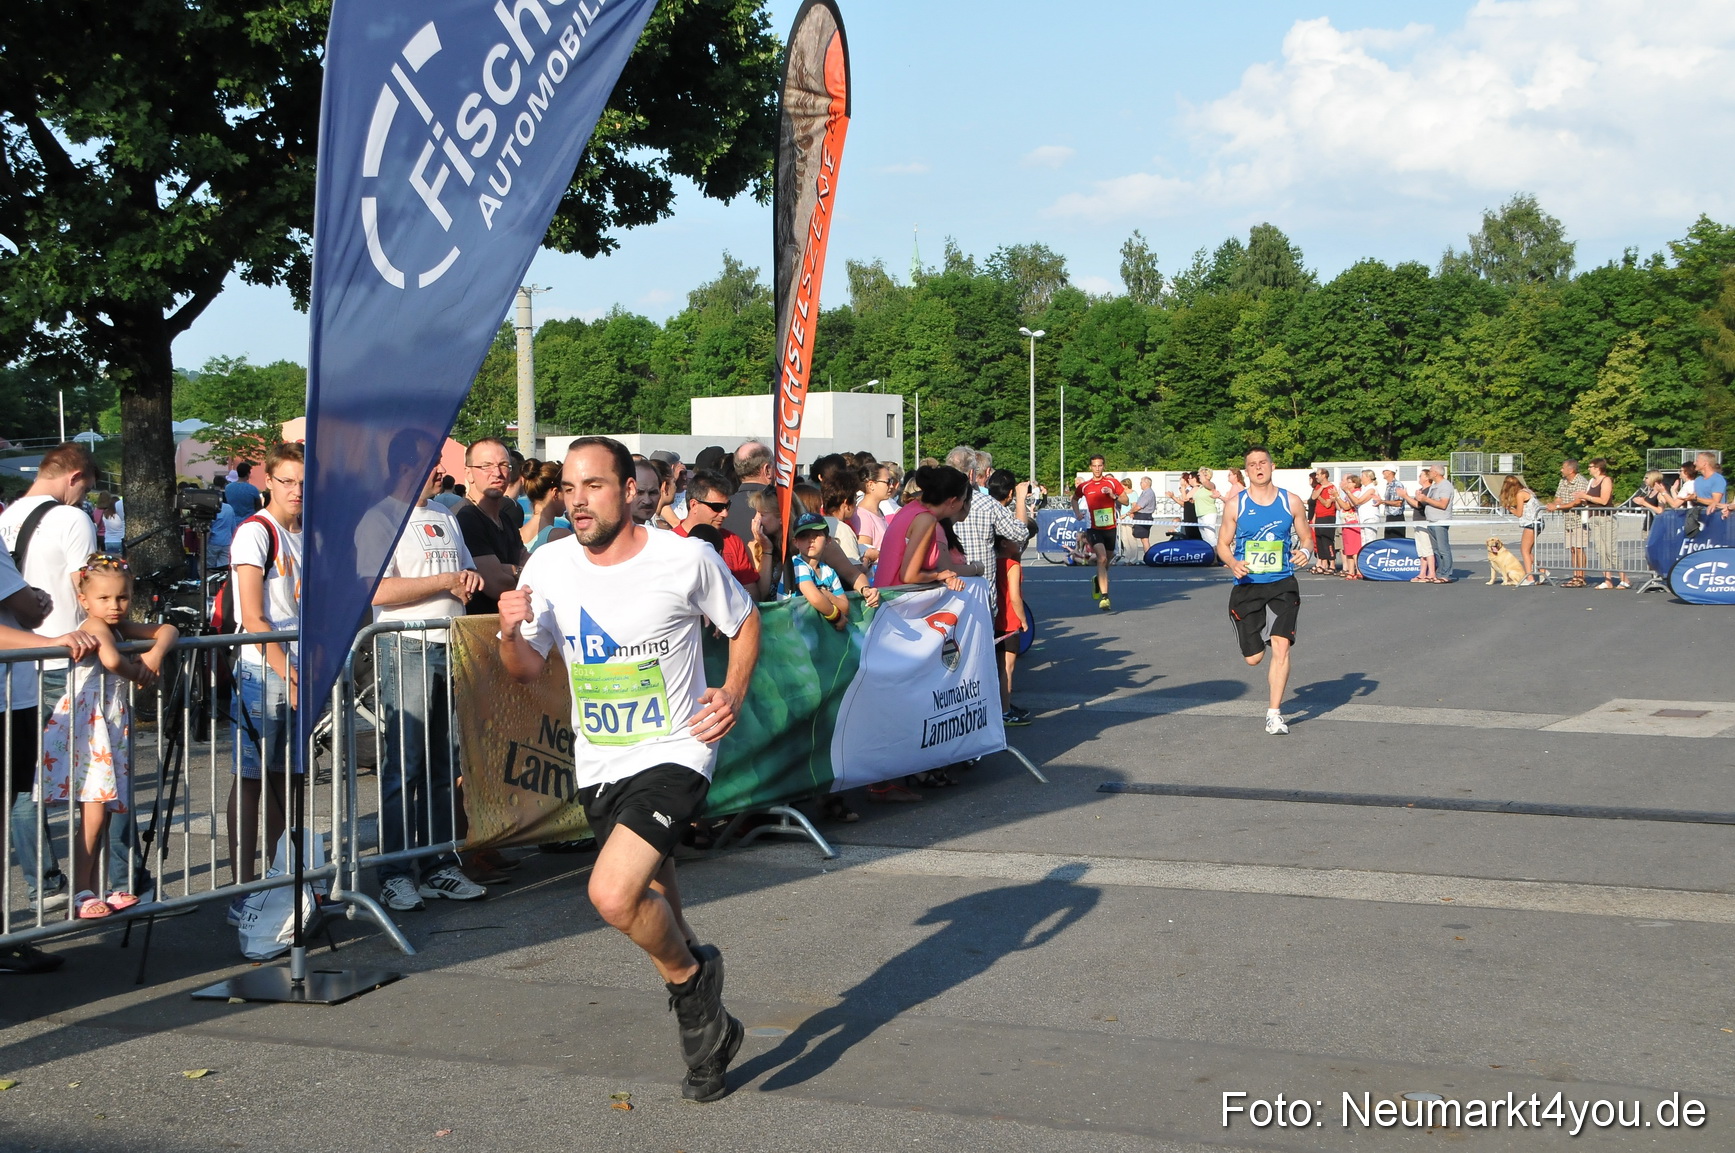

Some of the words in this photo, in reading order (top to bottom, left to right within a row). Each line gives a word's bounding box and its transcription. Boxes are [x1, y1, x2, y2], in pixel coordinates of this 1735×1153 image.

[408, 0, 566, 232] Fisch
[478, 0, 606, 231] AUTOMOBIL
[1100, 514, 1109, 522] 13
[1056, 527, 1082, 540] Fisc
[425, 551, 459, 560] POLGER
[1163, 552, 1206, 563] Fischer
[1251, 552, 1276, 565] 746
[586, 634, 670, 658] Running
[573, 667, 596, 676] 2014
[932, 679, 981, 711] Neumarkter
[584, 696, 665, 734] 5074
[920, 700, 988, 749] Lammsbräu
